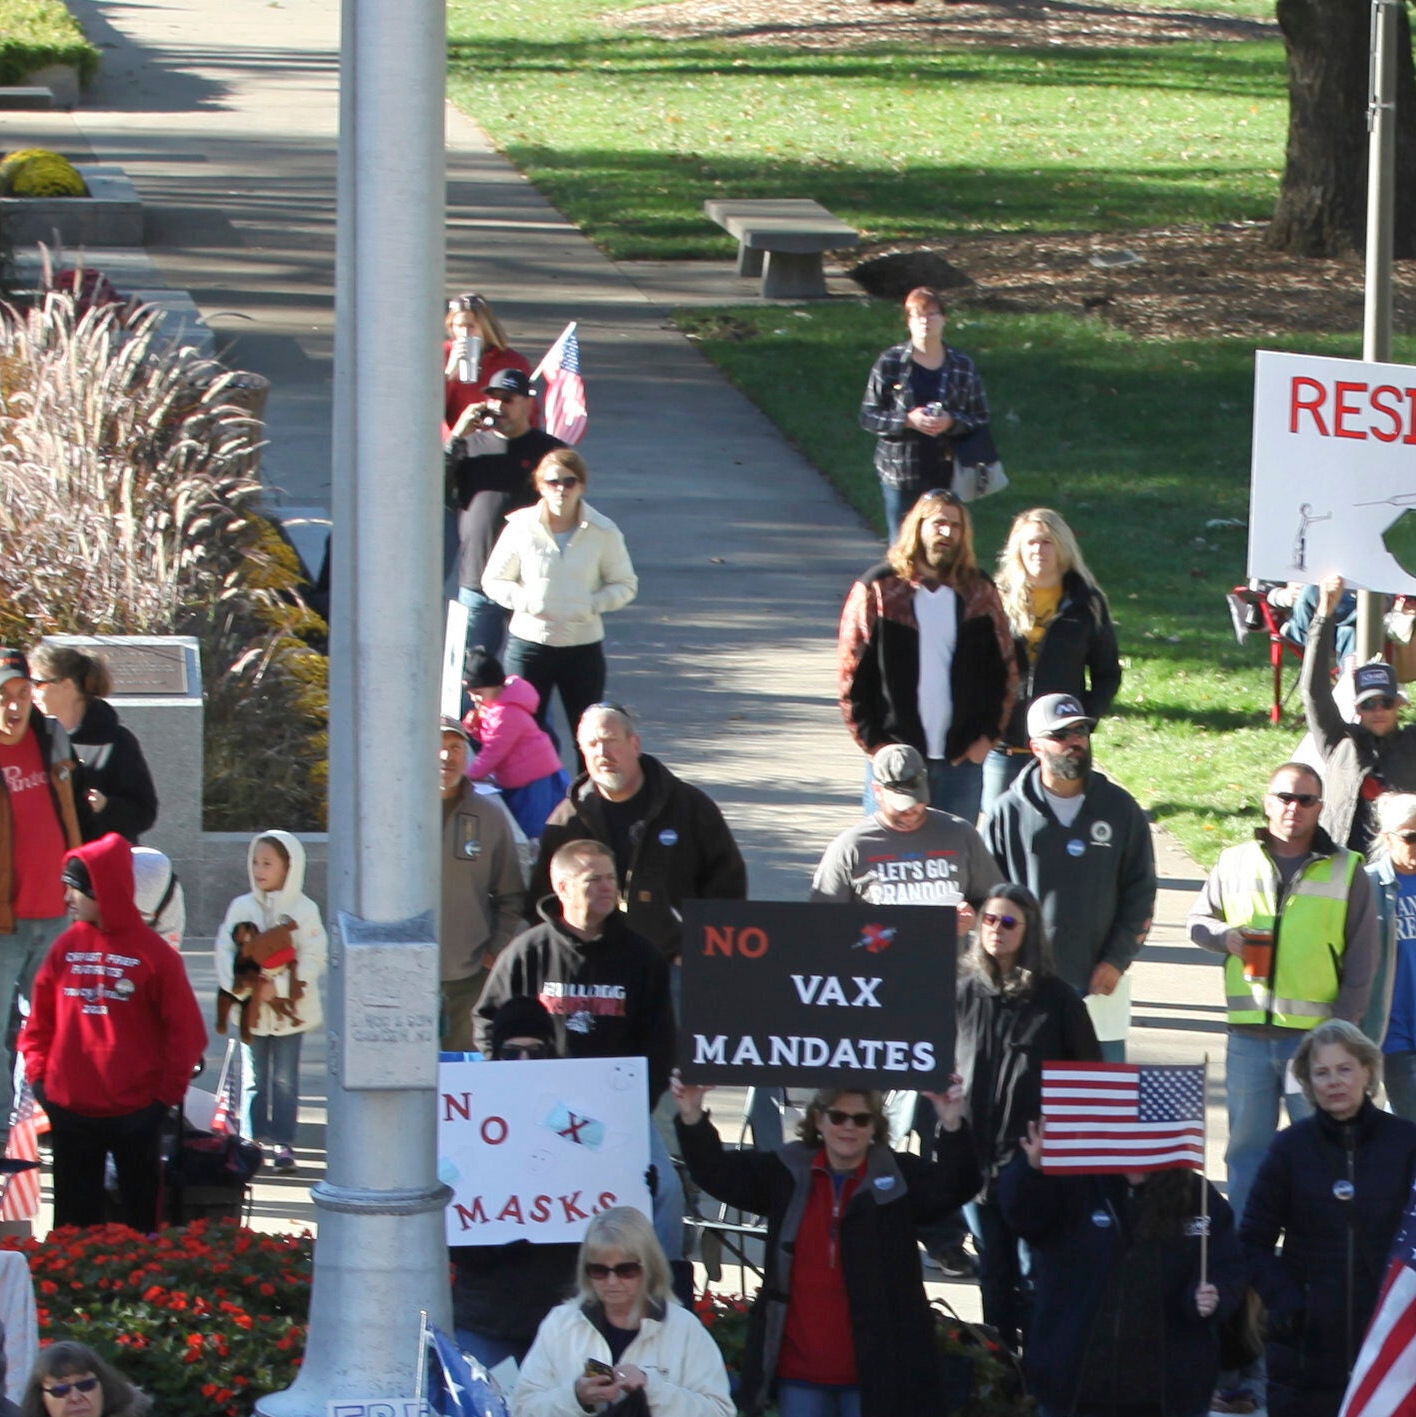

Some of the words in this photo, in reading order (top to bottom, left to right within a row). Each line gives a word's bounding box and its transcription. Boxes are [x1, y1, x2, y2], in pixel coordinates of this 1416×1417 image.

[877, 860, 924, 881] LET'S
[925, 858, 950, 879] GO
[703, 925, 770, 958] NO
[790, 974, 883, 1007] VAX
[693, 1033, 936, 1072] MANDATES
[442, 1092, 509, 1145] NO
